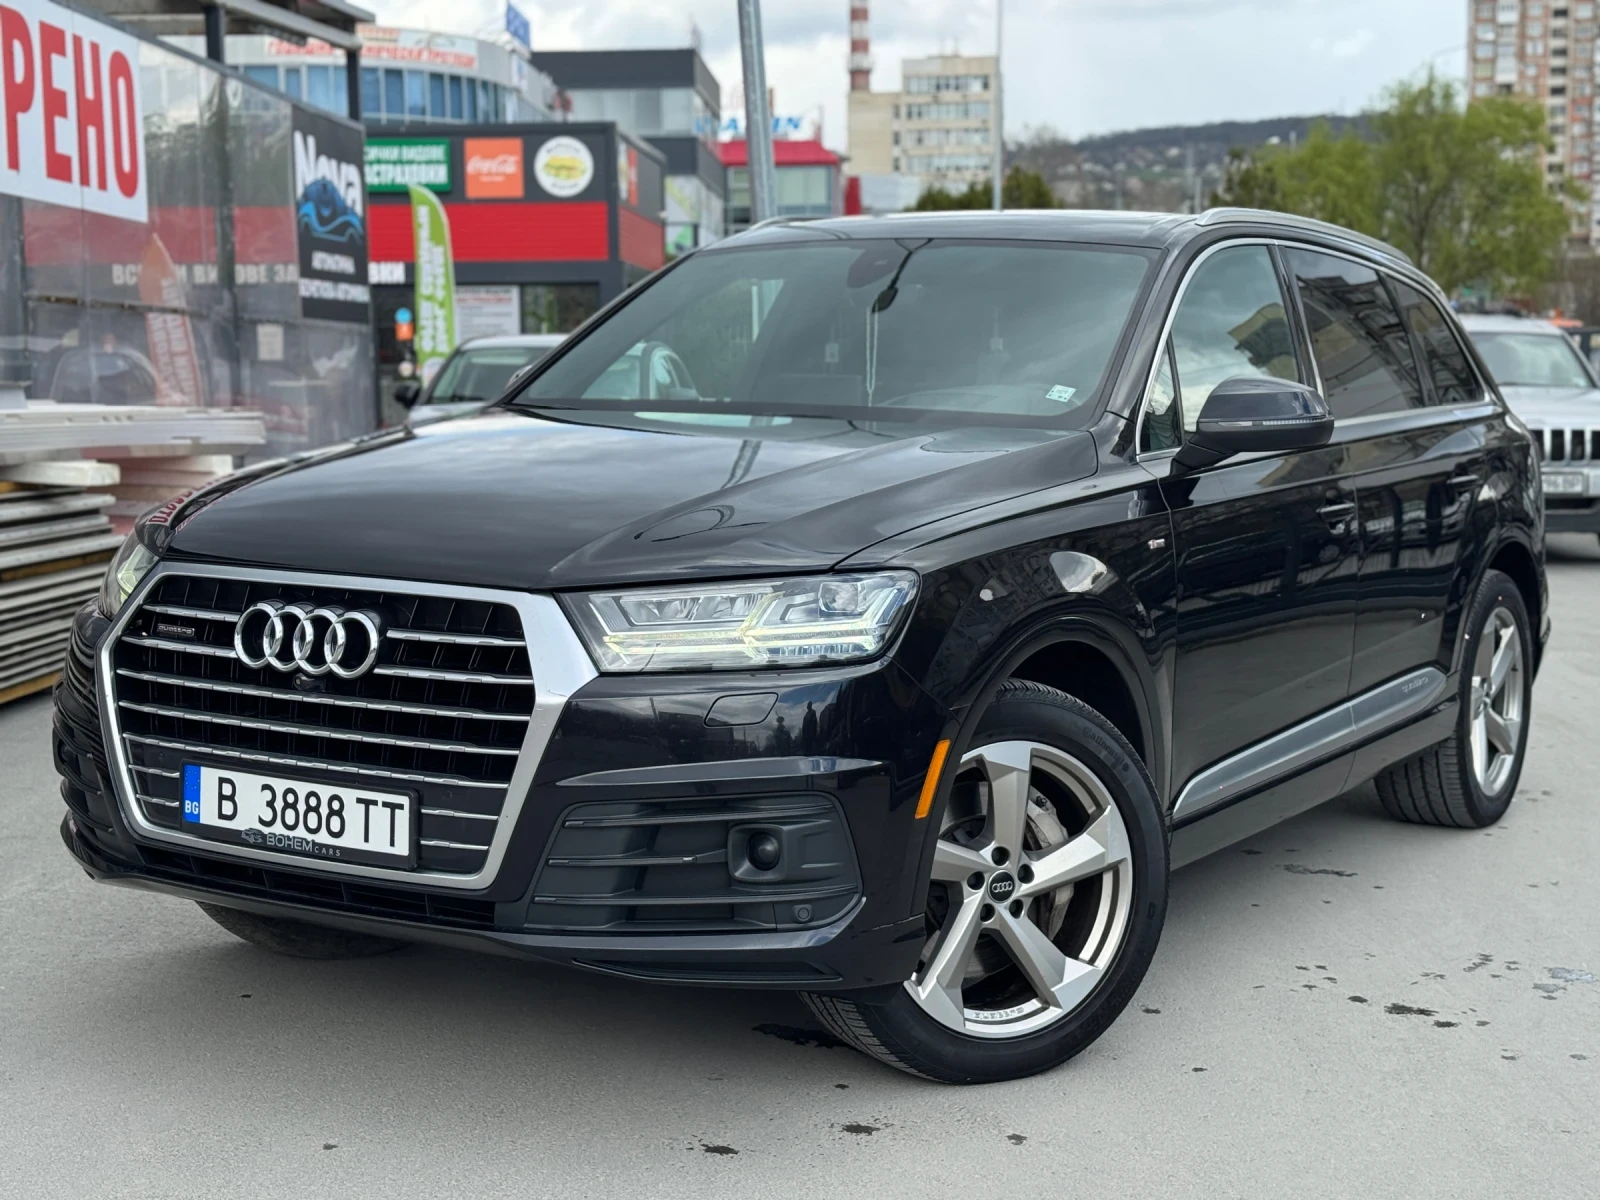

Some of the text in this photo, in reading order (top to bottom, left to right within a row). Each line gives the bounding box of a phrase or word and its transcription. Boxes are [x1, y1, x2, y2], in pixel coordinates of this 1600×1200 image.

[184, 799, 200, 815] BG
[216, 776, 405, 848] B 3888 TT
[266, 833, 342, 858] BOHEM CARS
